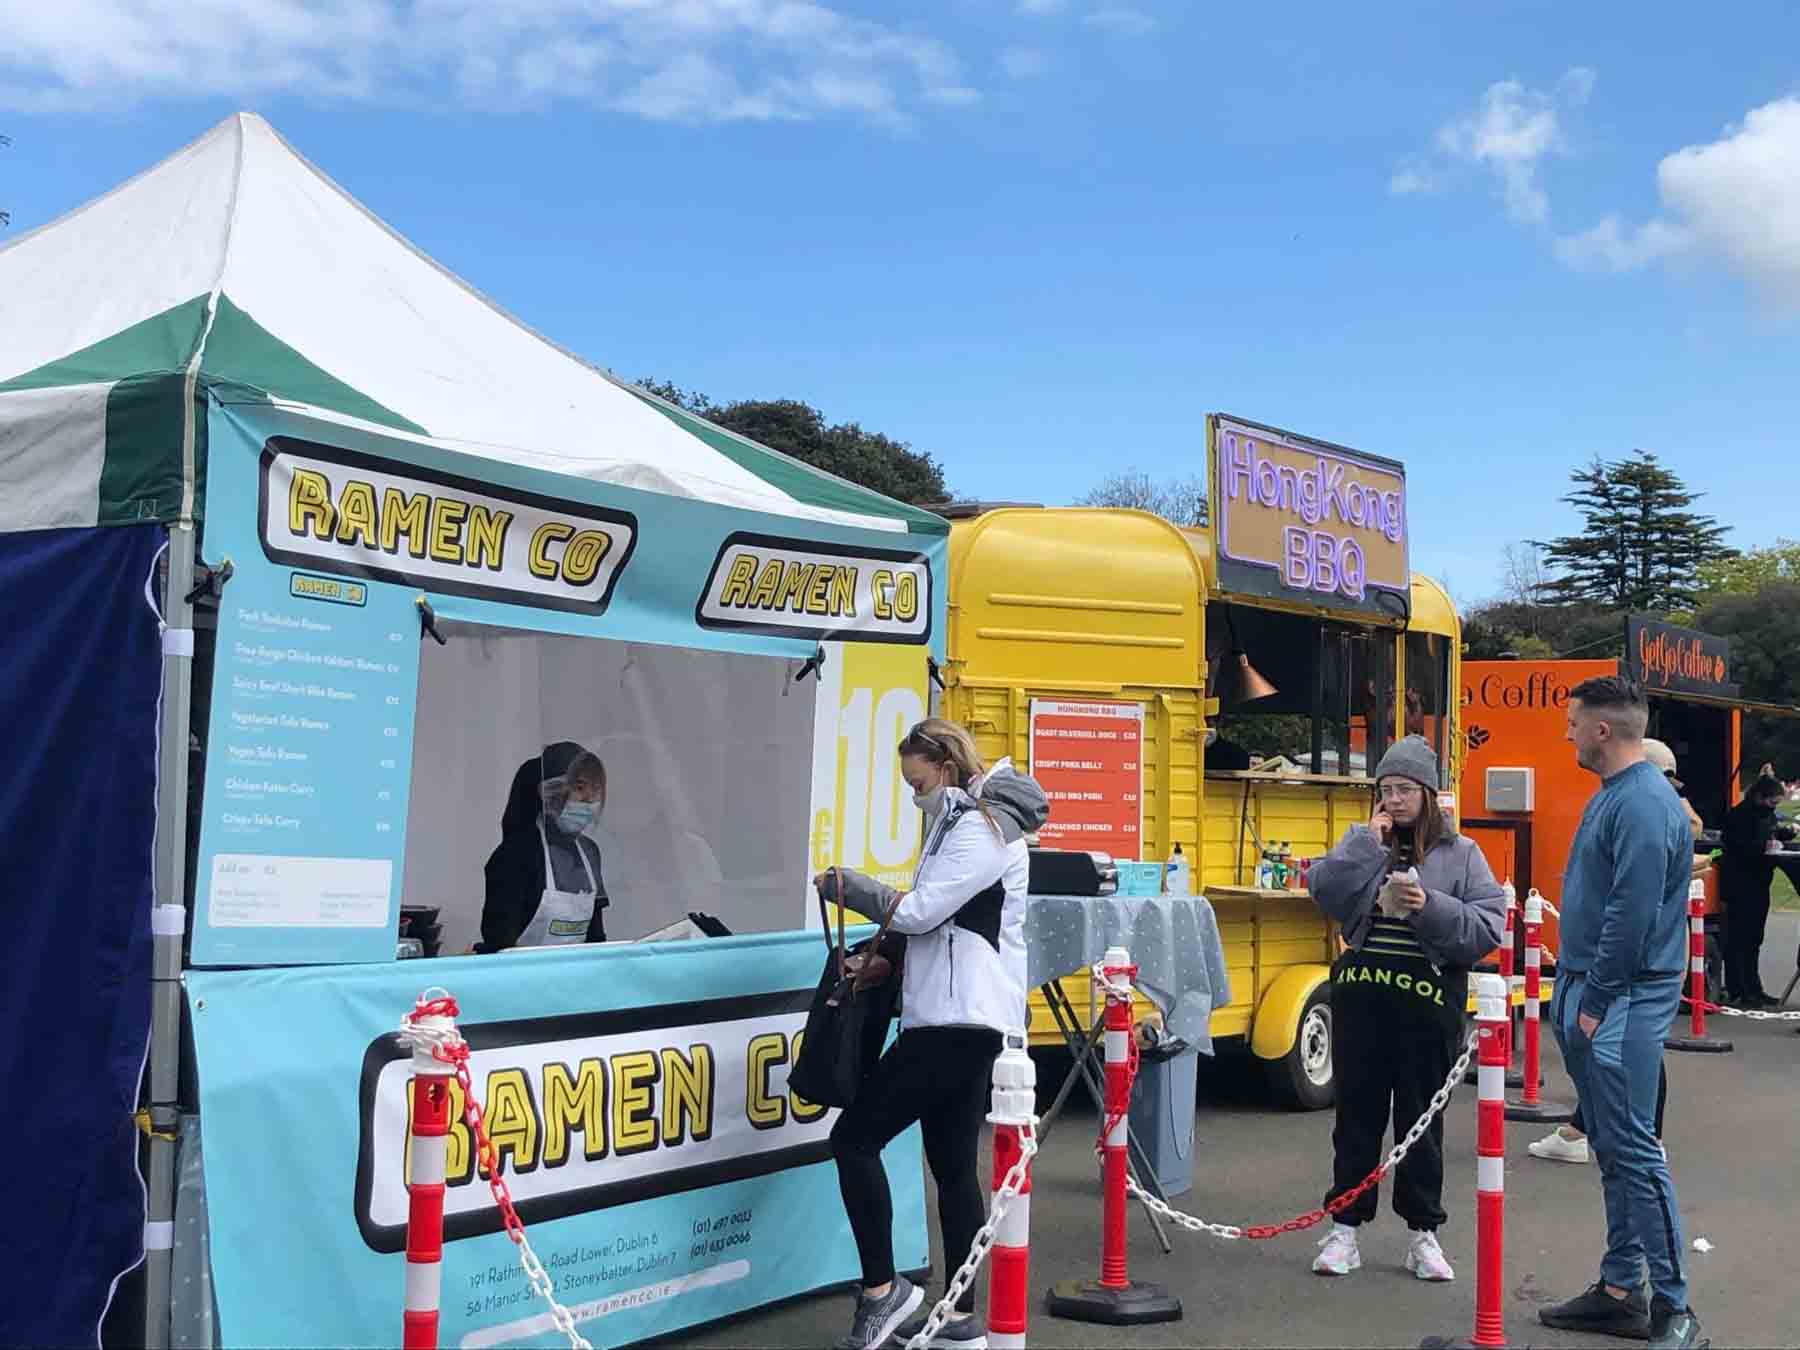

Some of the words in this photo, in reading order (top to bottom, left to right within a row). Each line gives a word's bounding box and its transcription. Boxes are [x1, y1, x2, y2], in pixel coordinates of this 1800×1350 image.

[288, 466, 513, 571] RAMEN
[527, 520, 614, 586] CO
[719, 554, 857, 618] RAMEN
[871, 569, 918, 623] CO
[1283, 526, 1365, 601] BBQ
[1481, 672, 1572, 709] Coffe
[1346, 966, 1445, 1006] KANGOL
[551, 1251, 578, 1269] Road
[581, 1243, 615, 1265] Lower,
[616, 1234, 649, 1253] Dublin
[485, 1291, 521, 1311] Manor
[637, 1252, 668, 1272] Dublin
